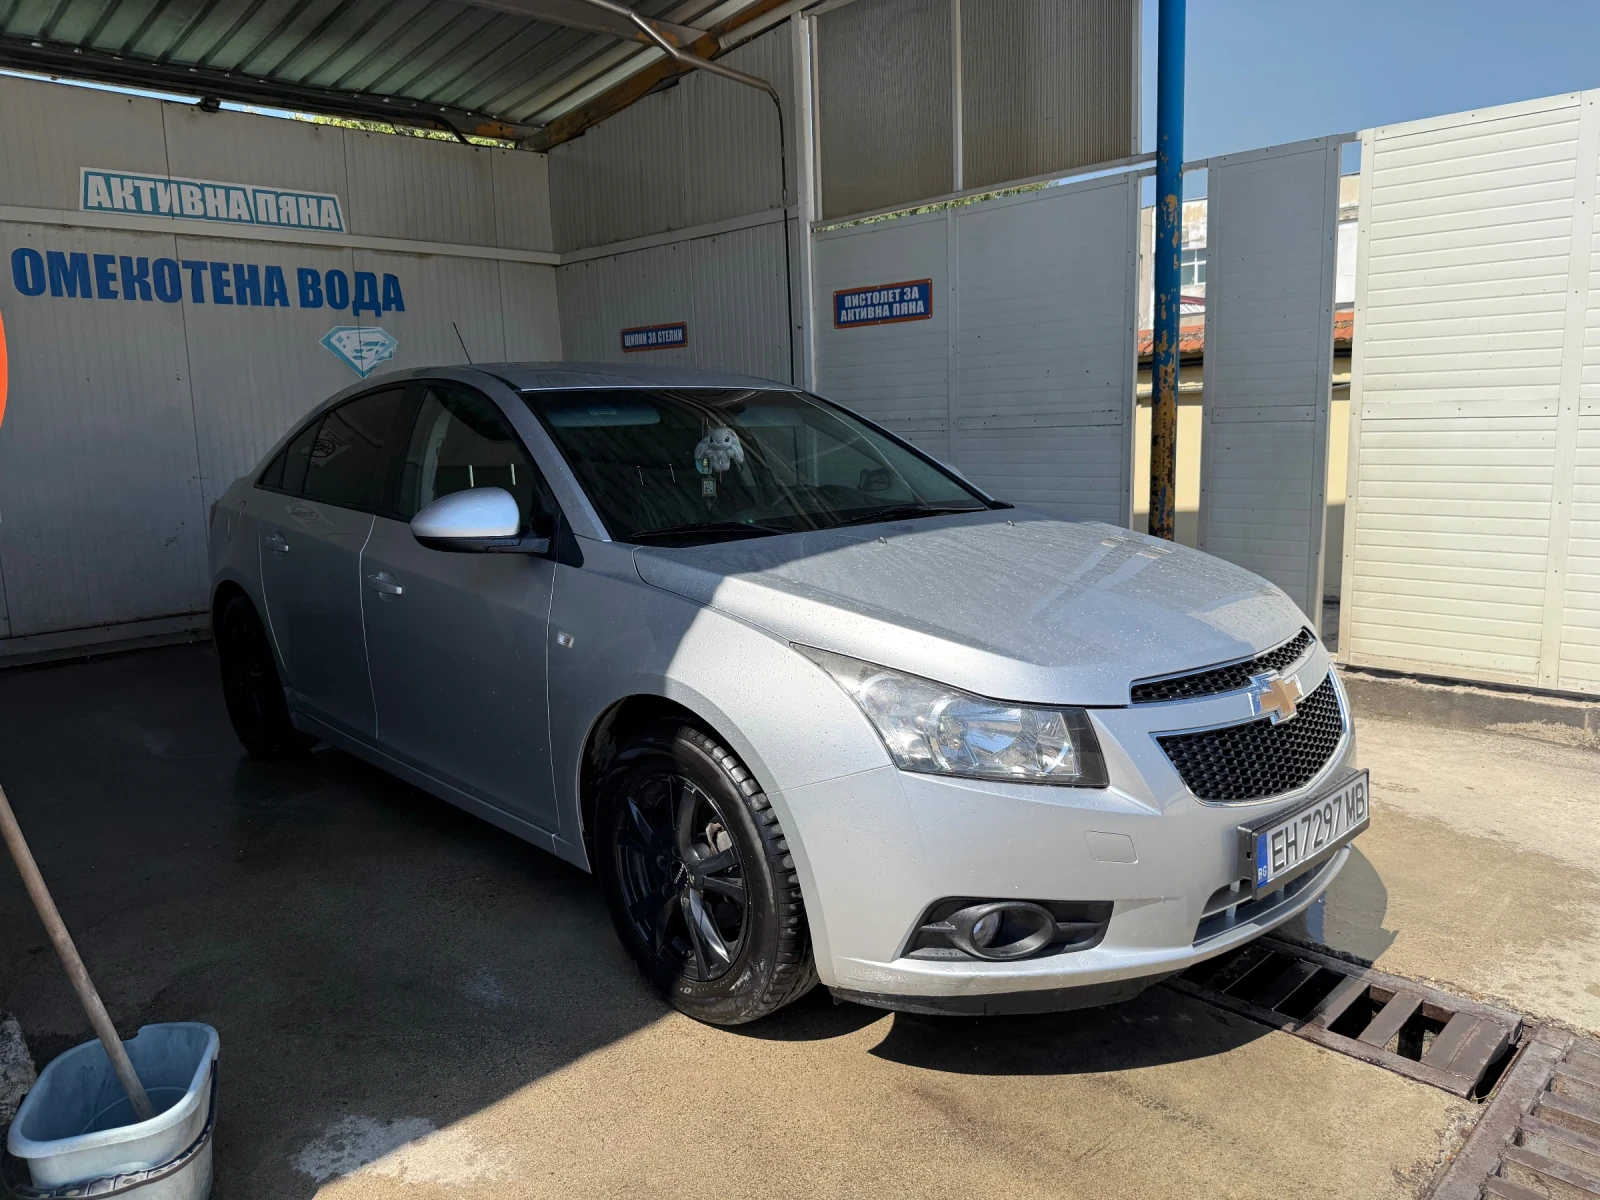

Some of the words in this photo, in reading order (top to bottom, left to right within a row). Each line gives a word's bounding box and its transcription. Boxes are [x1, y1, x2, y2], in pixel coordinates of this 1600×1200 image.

[87, 174, 252, 221] АКТИВНА
[257, 192, 339, 229] ПЯНА
[11, 247, 289, 307] ОМЕКОТЕНА
[297, 267, 405, 317] ВОДА
[844, 288, 901, 307] ПИСТОЛЕТ
[904, 286, 919, 300] ЗА
[841, 304, 890, 322] АКТИВНА
[893, 300, 925, 316] ПЯНА
[624, 332, 648, 348] ЩИПКИ
[648, 331, 657, 344] ЗА
[657, 328, 683, 343] СТЕЛКИ
[1257, 865, 1268, 880] BG
